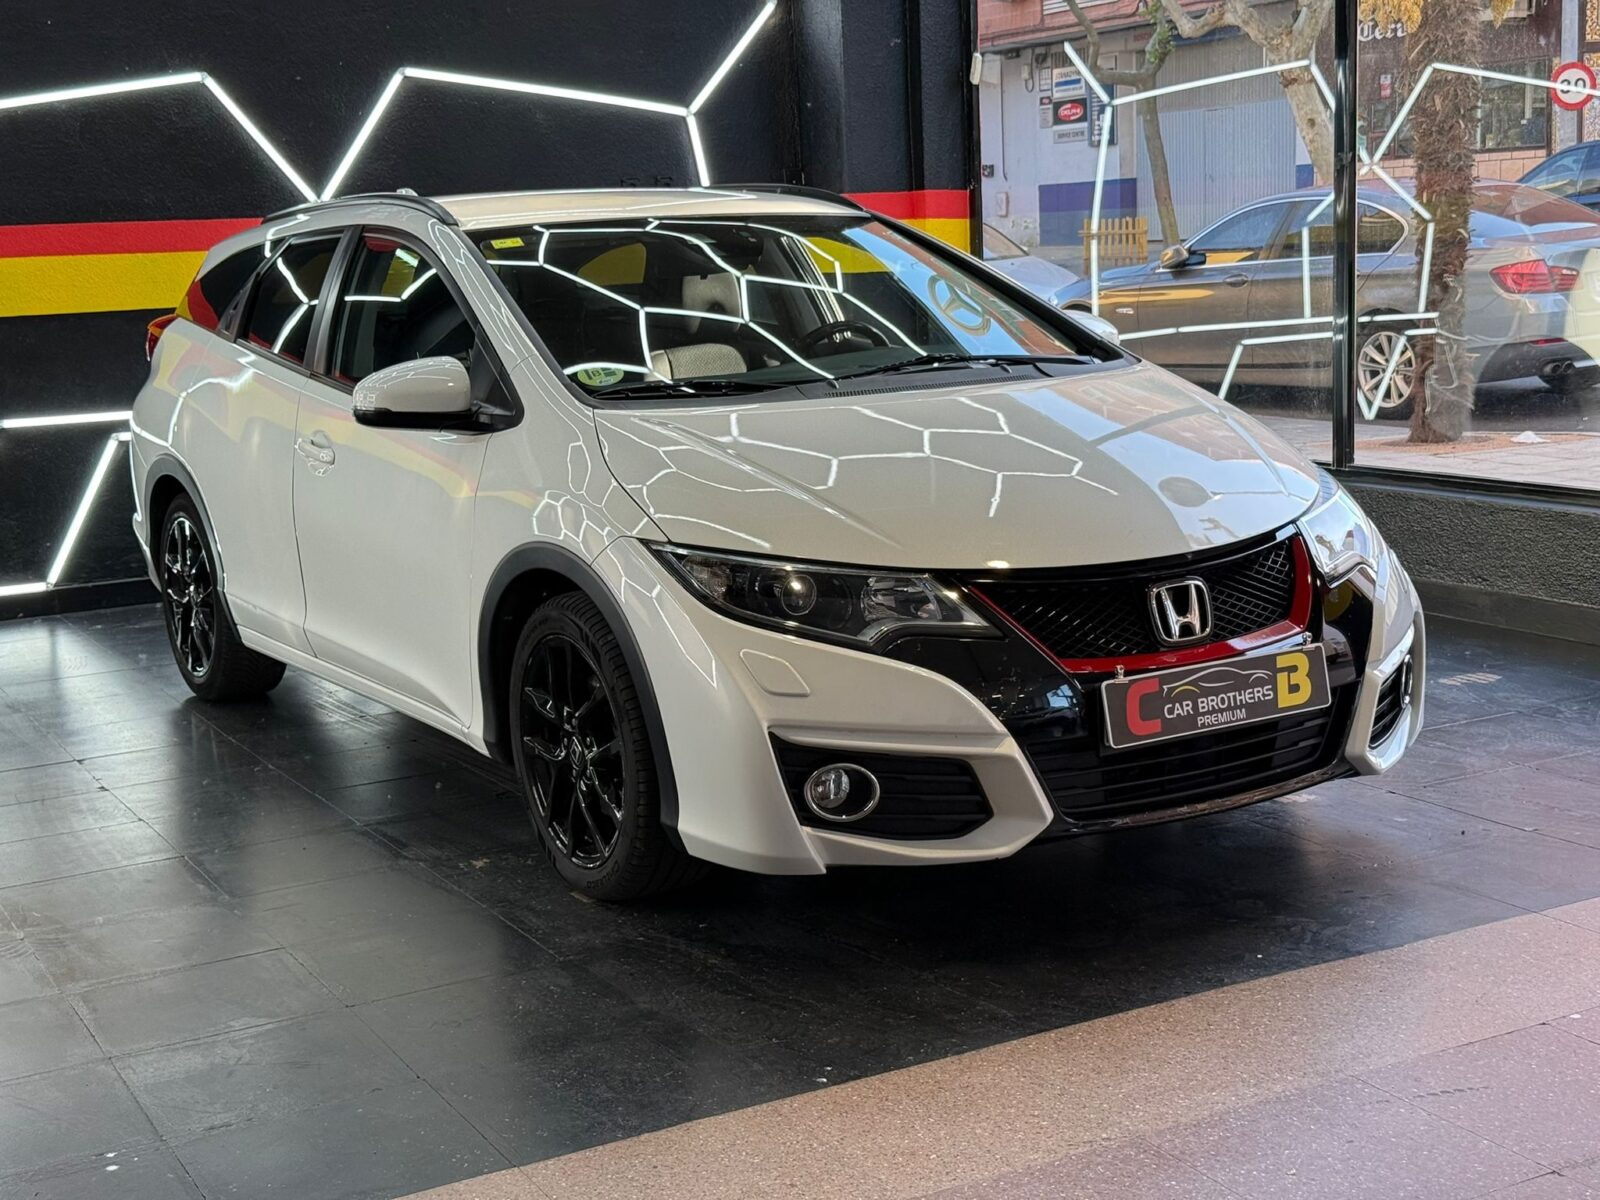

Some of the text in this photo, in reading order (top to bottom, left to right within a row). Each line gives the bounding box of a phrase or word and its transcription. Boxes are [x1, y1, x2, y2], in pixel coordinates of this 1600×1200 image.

[1164, 685, 1274, 719] CAR BROTHERS
[1276, 652, 1312, 709] B
[1126, 677, 1162, 736] C
[1197, 708, 1247, 727] PREMIUM
